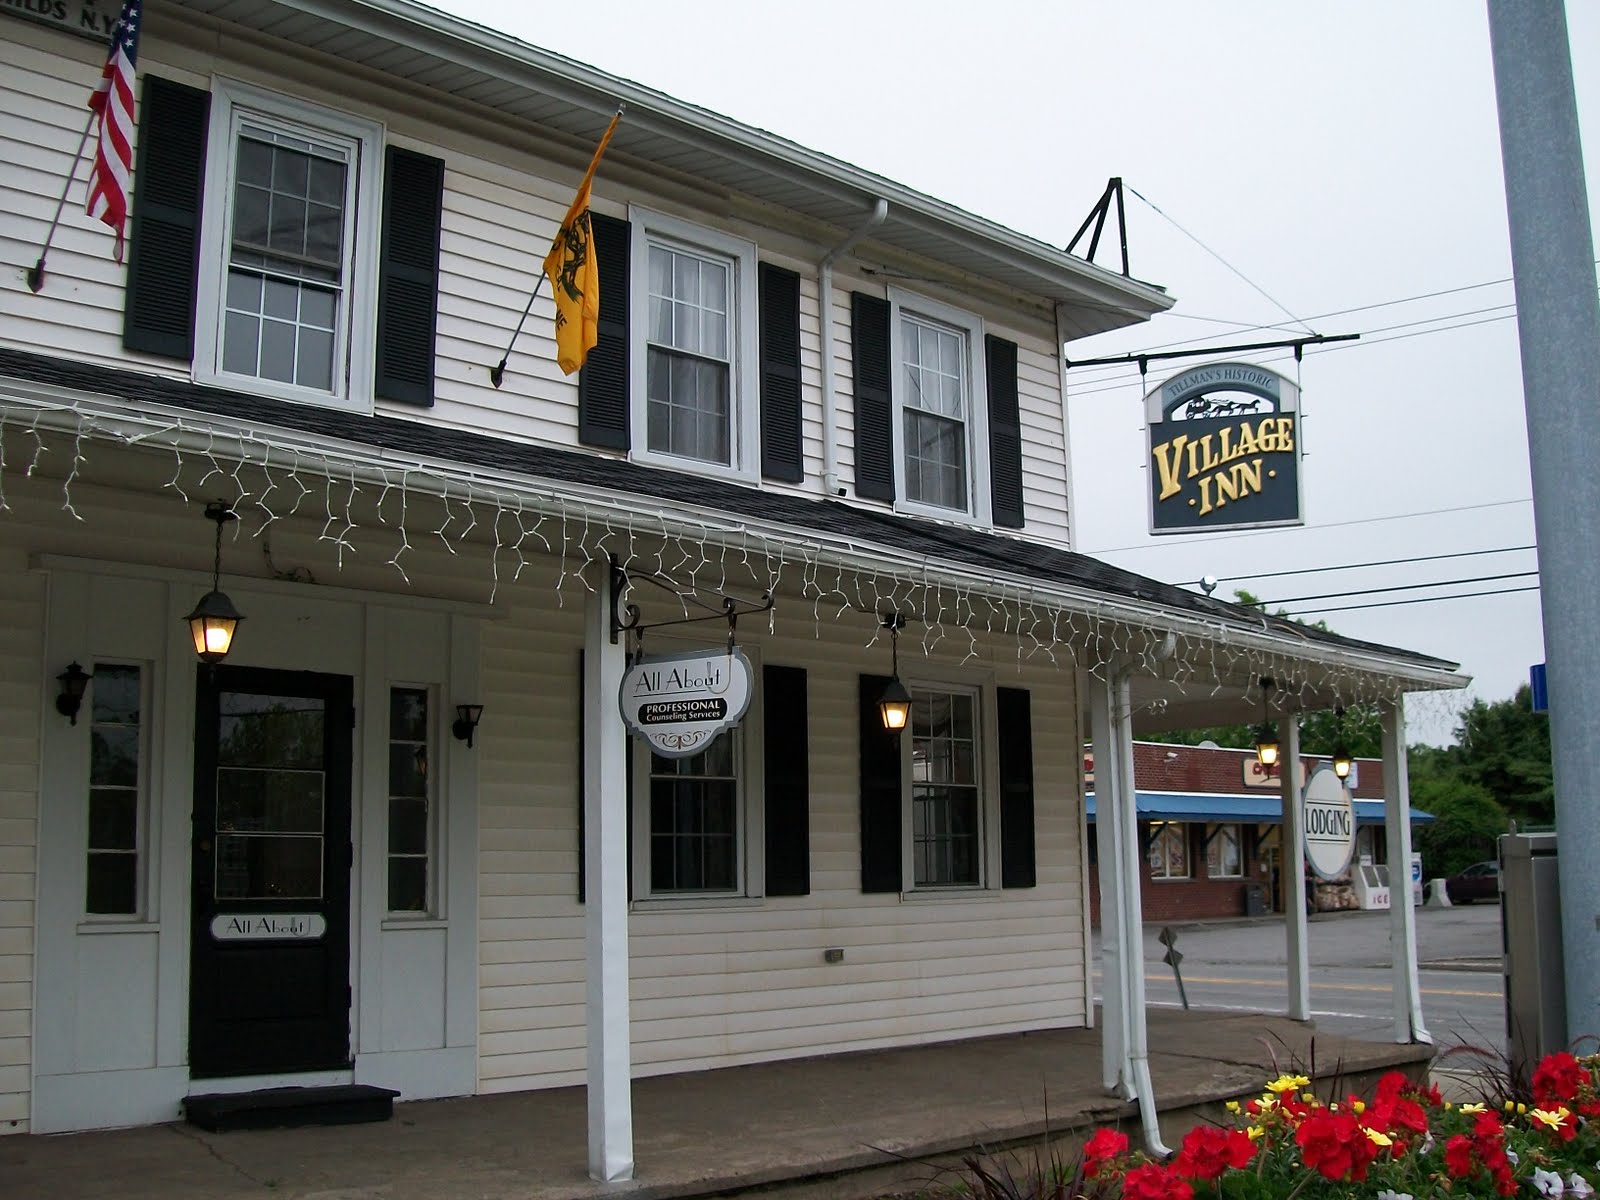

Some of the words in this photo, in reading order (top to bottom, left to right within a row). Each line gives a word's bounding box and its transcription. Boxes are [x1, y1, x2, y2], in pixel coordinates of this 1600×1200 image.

[1168, 369, 1221, 396] TILLMAN'S
[1224, 368, 1274, 389] HISTORIC
[1152, 418, 1294, 501] VILLAGE
[1198, 458, 1263, 516] INN
[635, 671, 660, 692] All
[666, 663, 721, 691] About
[646, 700, 721, 713] PROFESSIONAL
[646, 711, 687, 721] Counseling
[688, 710, 721, 719] Services
[1304, 808, 1350, 836] LODGING
[1373, 894, 1388, 904] ICE
[226, 917, 250, 933] All
[256, 917, 304, 933] About
